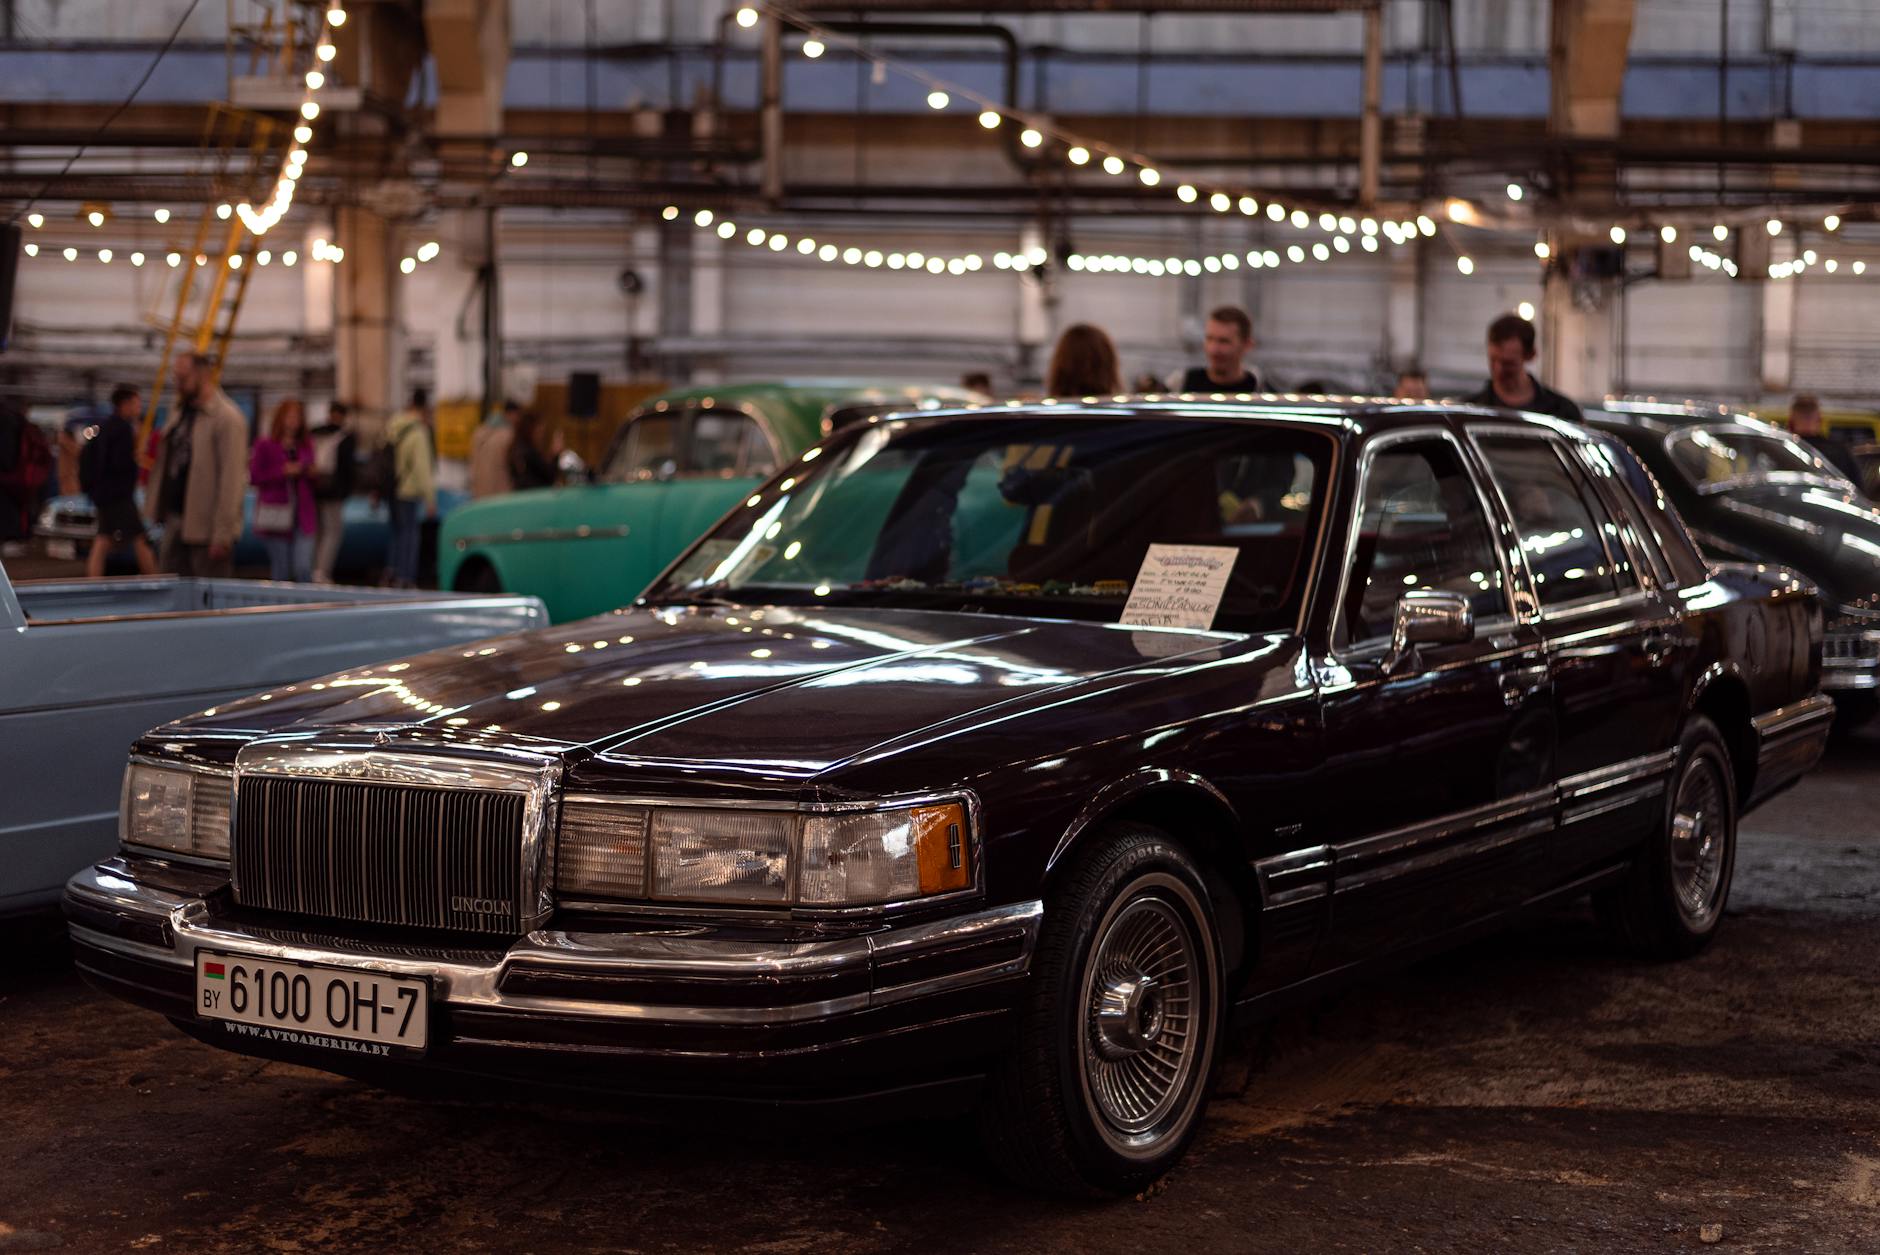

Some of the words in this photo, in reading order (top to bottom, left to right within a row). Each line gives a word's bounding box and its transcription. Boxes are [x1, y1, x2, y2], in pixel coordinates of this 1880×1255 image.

[451, 896, 511, 915] LINCOLN
[203, 988, 221, 1009] BY
[230, 965, 311, 1023] 6100
[326, 979, 418, 1037] OH-7
[224, 1021, 391, 1057] WWW.AVTOAMERIKA.BY
